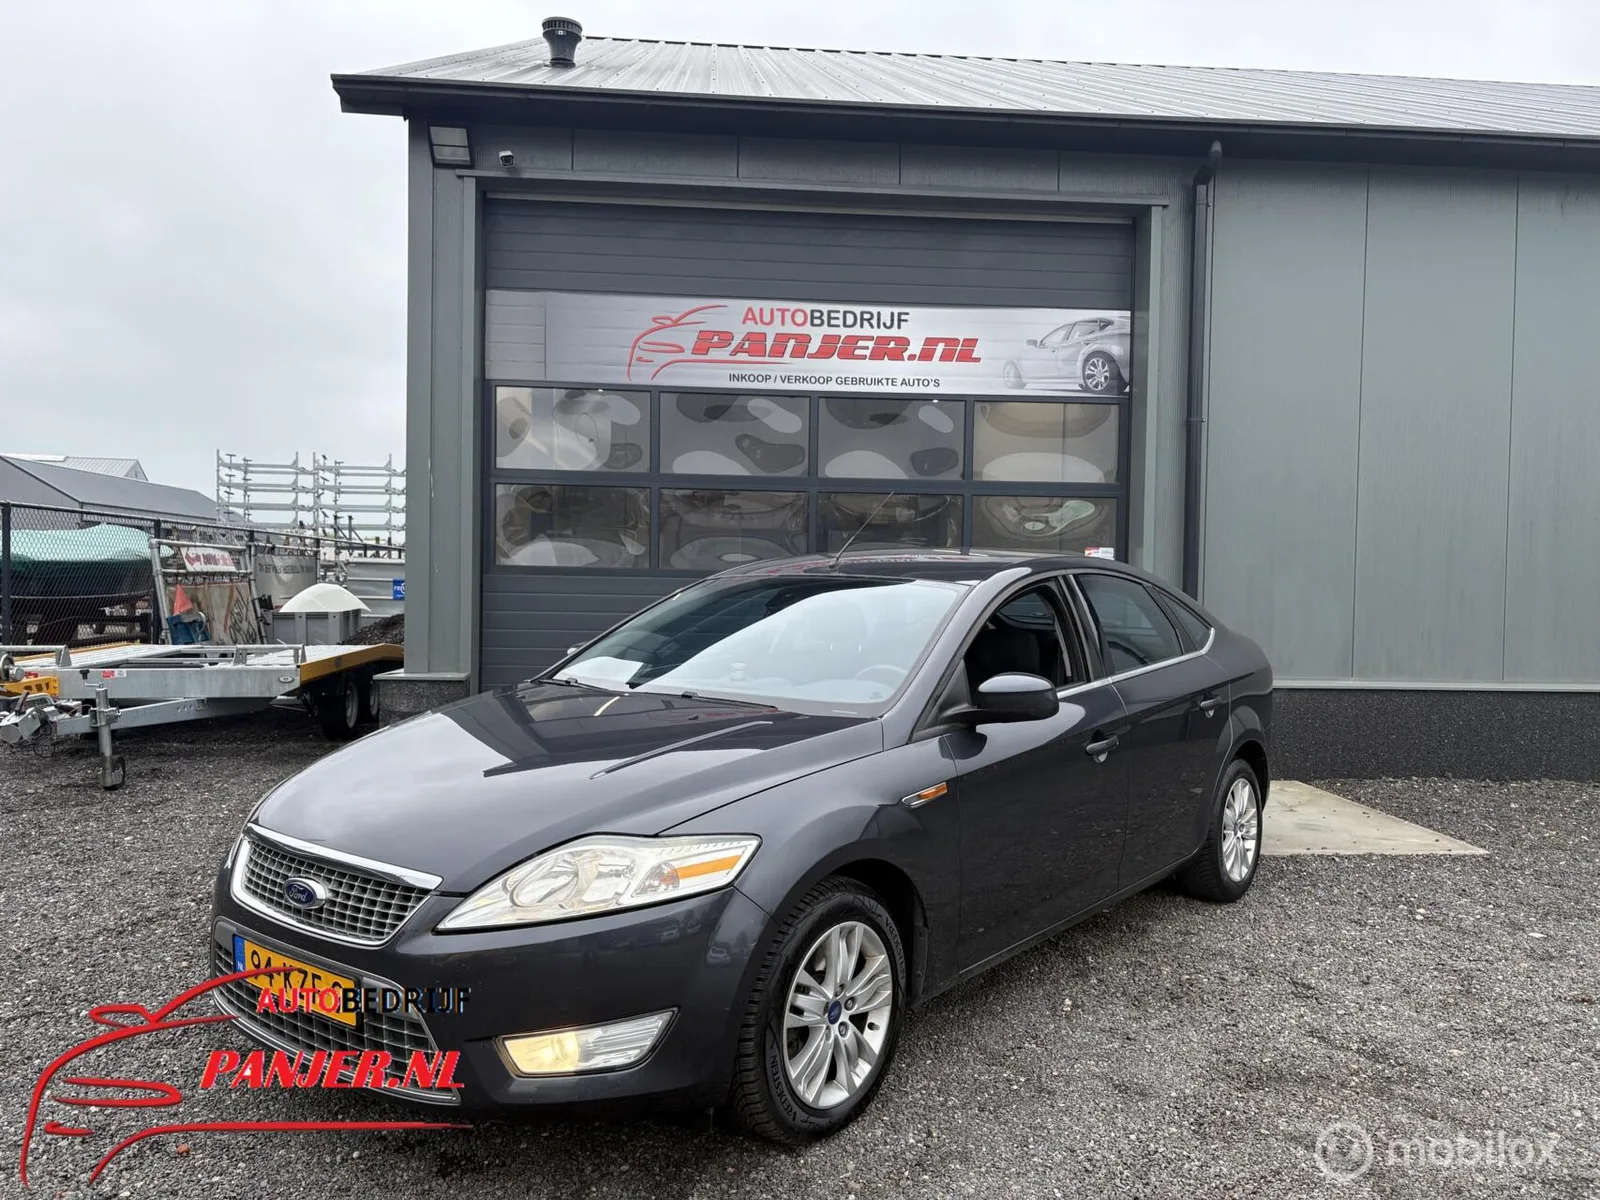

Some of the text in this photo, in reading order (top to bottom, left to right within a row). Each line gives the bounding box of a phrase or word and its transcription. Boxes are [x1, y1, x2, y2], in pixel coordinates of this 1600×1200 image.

[742, 306, 910, 331] AUTOBEDRIJF
[728, 373, 772, 383] INKOOP
[780, 374, 833, 385] VERKOOP
[835, 376, 899, 387] GEBRUIKTE
[900, 378, 940, 388] AUTO'S
[290, 884, 309, 902] Ford
